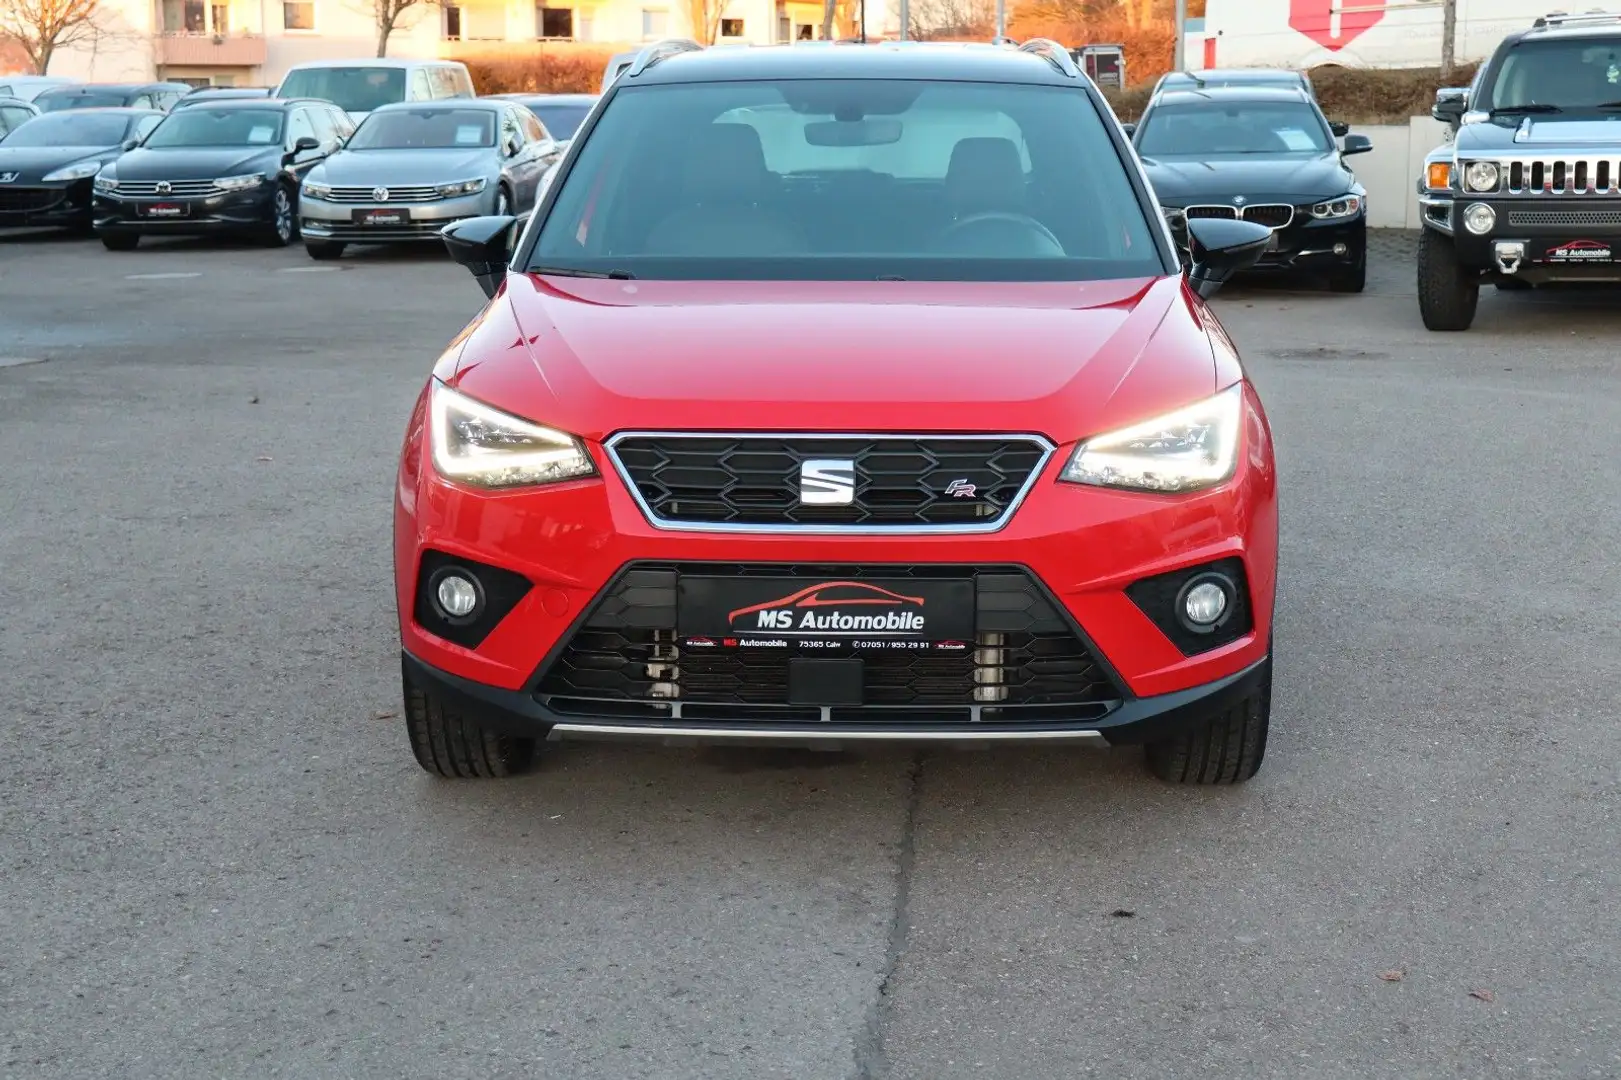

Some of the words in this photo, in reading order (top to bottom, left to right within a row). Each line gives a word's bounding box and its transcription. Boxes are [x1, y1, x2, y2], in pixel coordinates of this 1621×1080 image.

[1569, 248, 1611, 257] Automobile
[944, 478, 977, 498] FR
[757, 610, 793, 629] MS
[799, 610, 925, 630] Automobile
[723, 638, 737, 647] MS
[739, 639, 788, 648] Automobile
[798, 640, 824, 648] 75365
